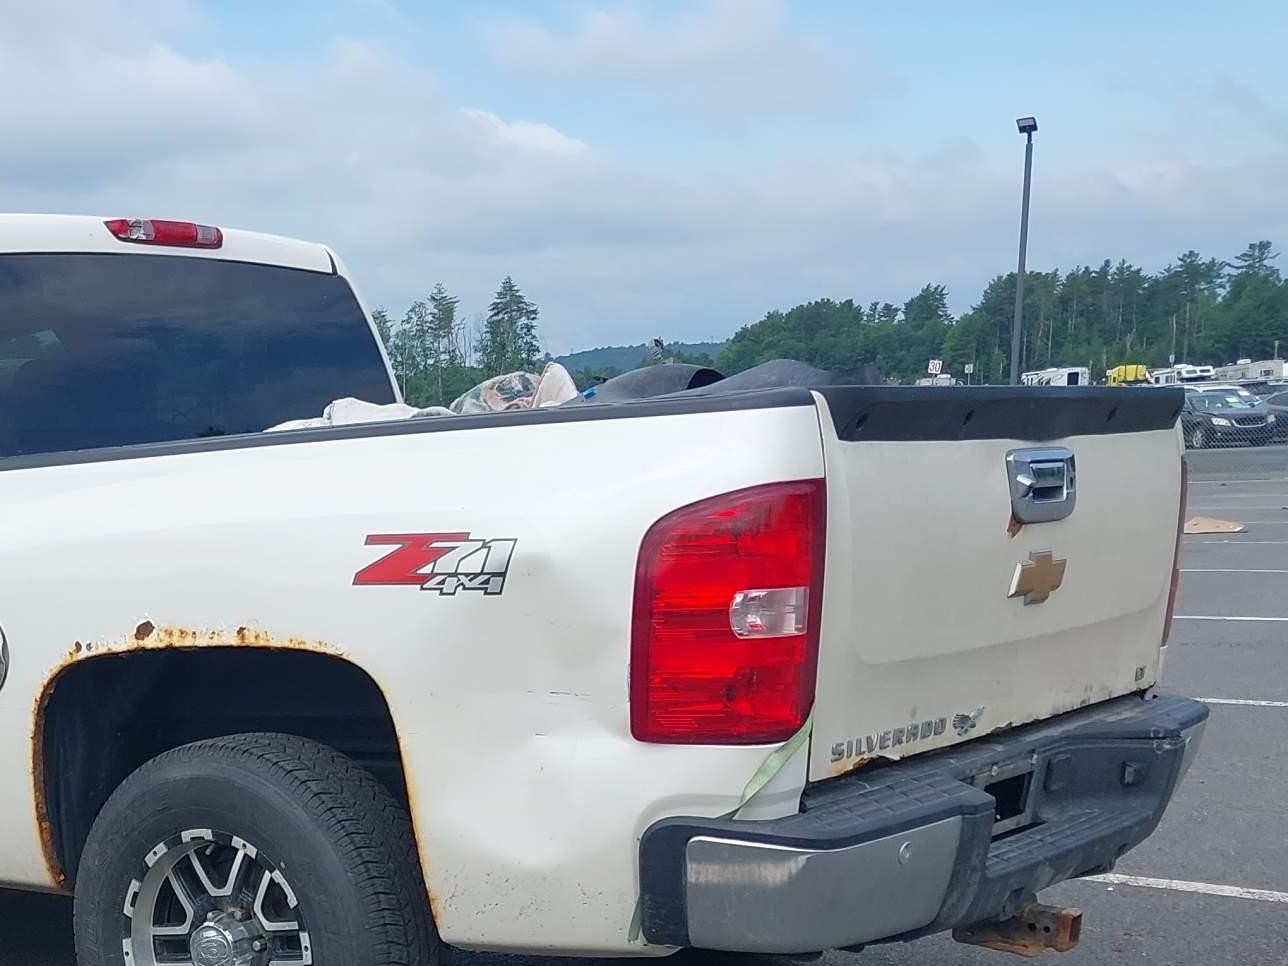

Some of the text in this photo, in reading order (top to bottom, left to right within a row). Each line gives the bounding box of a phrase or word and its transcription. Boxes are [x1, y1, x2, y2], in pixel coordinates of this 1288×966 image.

[929, 361, 941, 372] 30
[352, 532, 518, 585] Z71
[830, 717, 948, 763] SILVERADO
